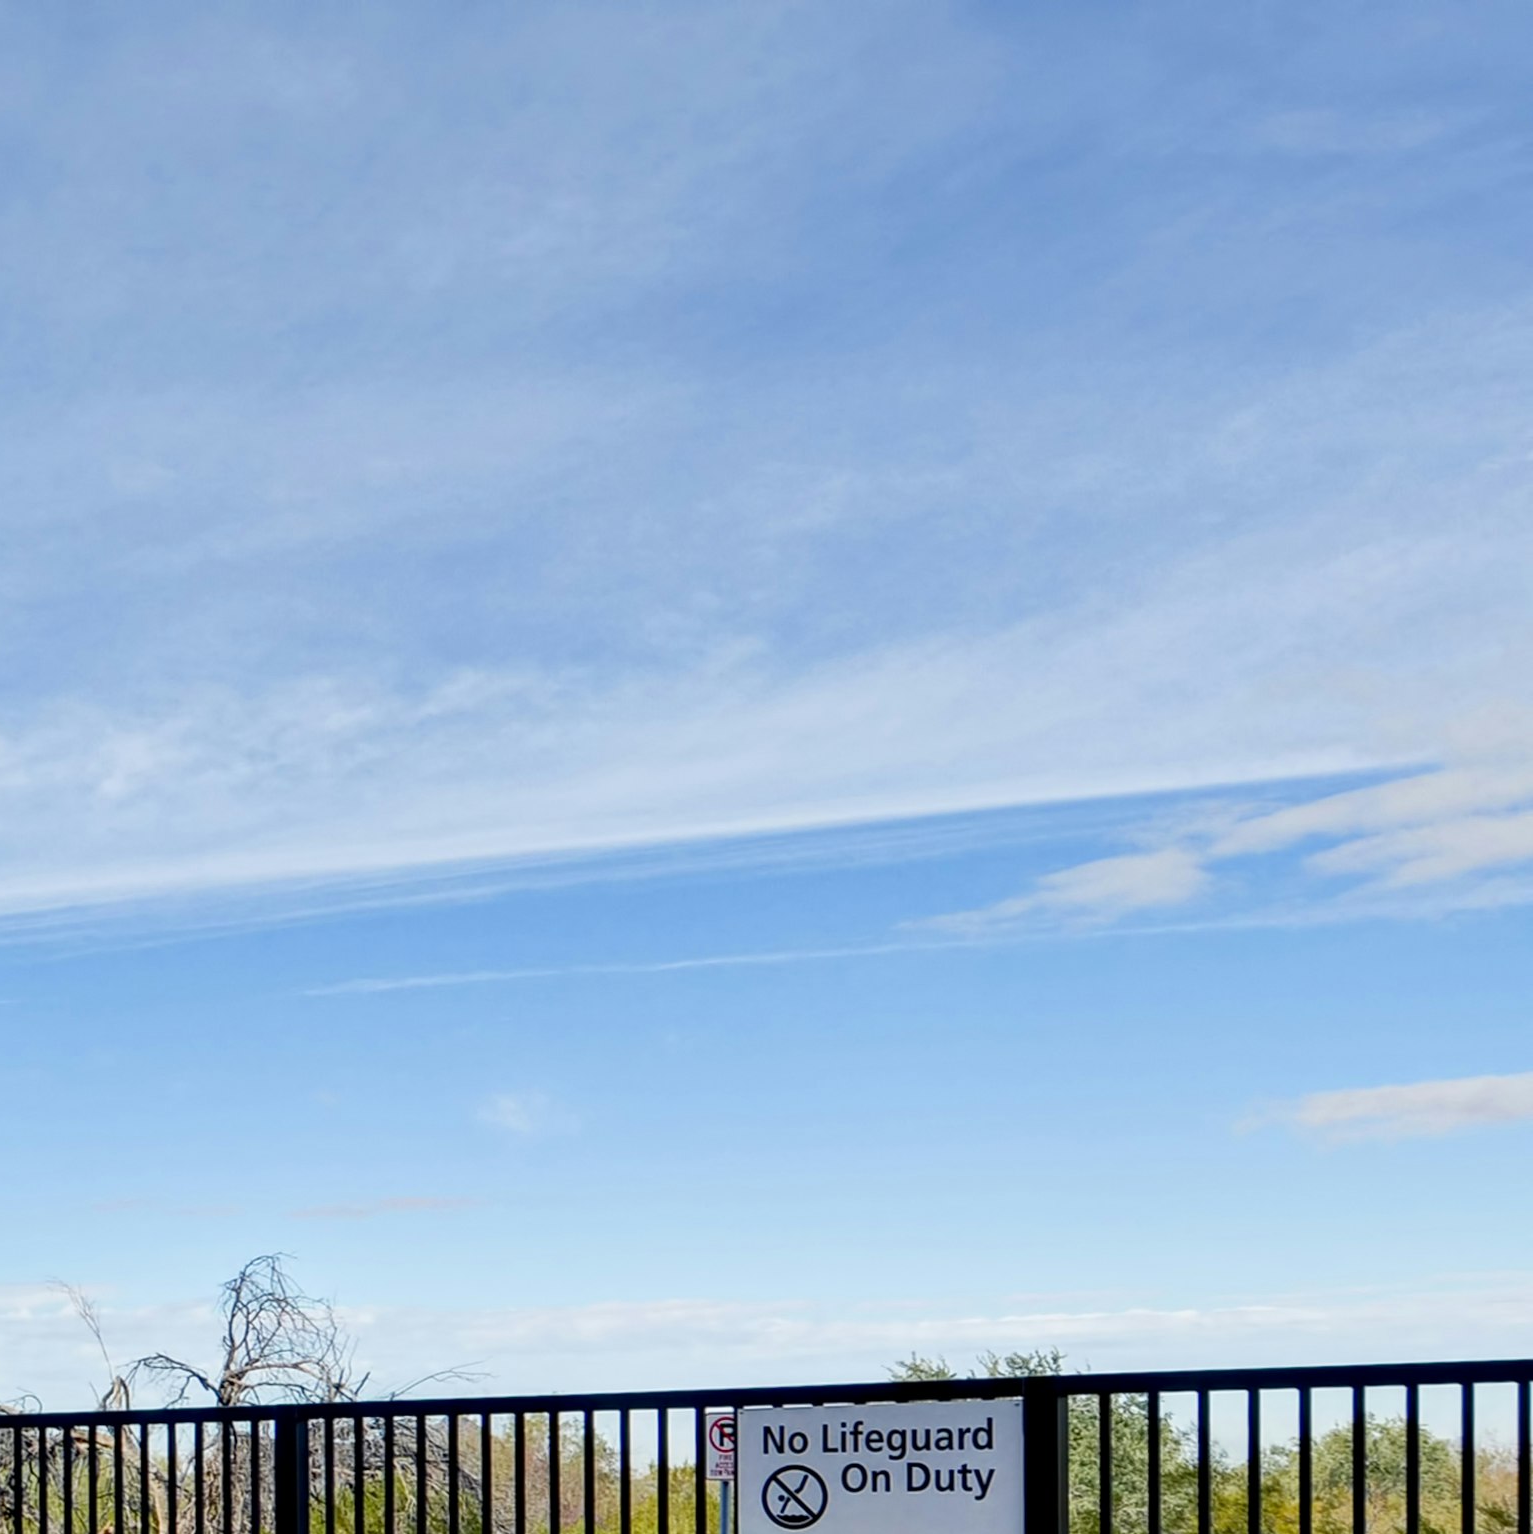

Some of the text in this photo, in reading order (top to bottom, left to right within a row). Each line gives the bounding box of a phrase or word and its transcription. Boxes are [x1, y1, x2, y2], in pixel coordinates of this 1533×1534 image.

[762, 1418, 994, 1461] No Lifeguard
[841, 1461, 995, 1500] On Duty
